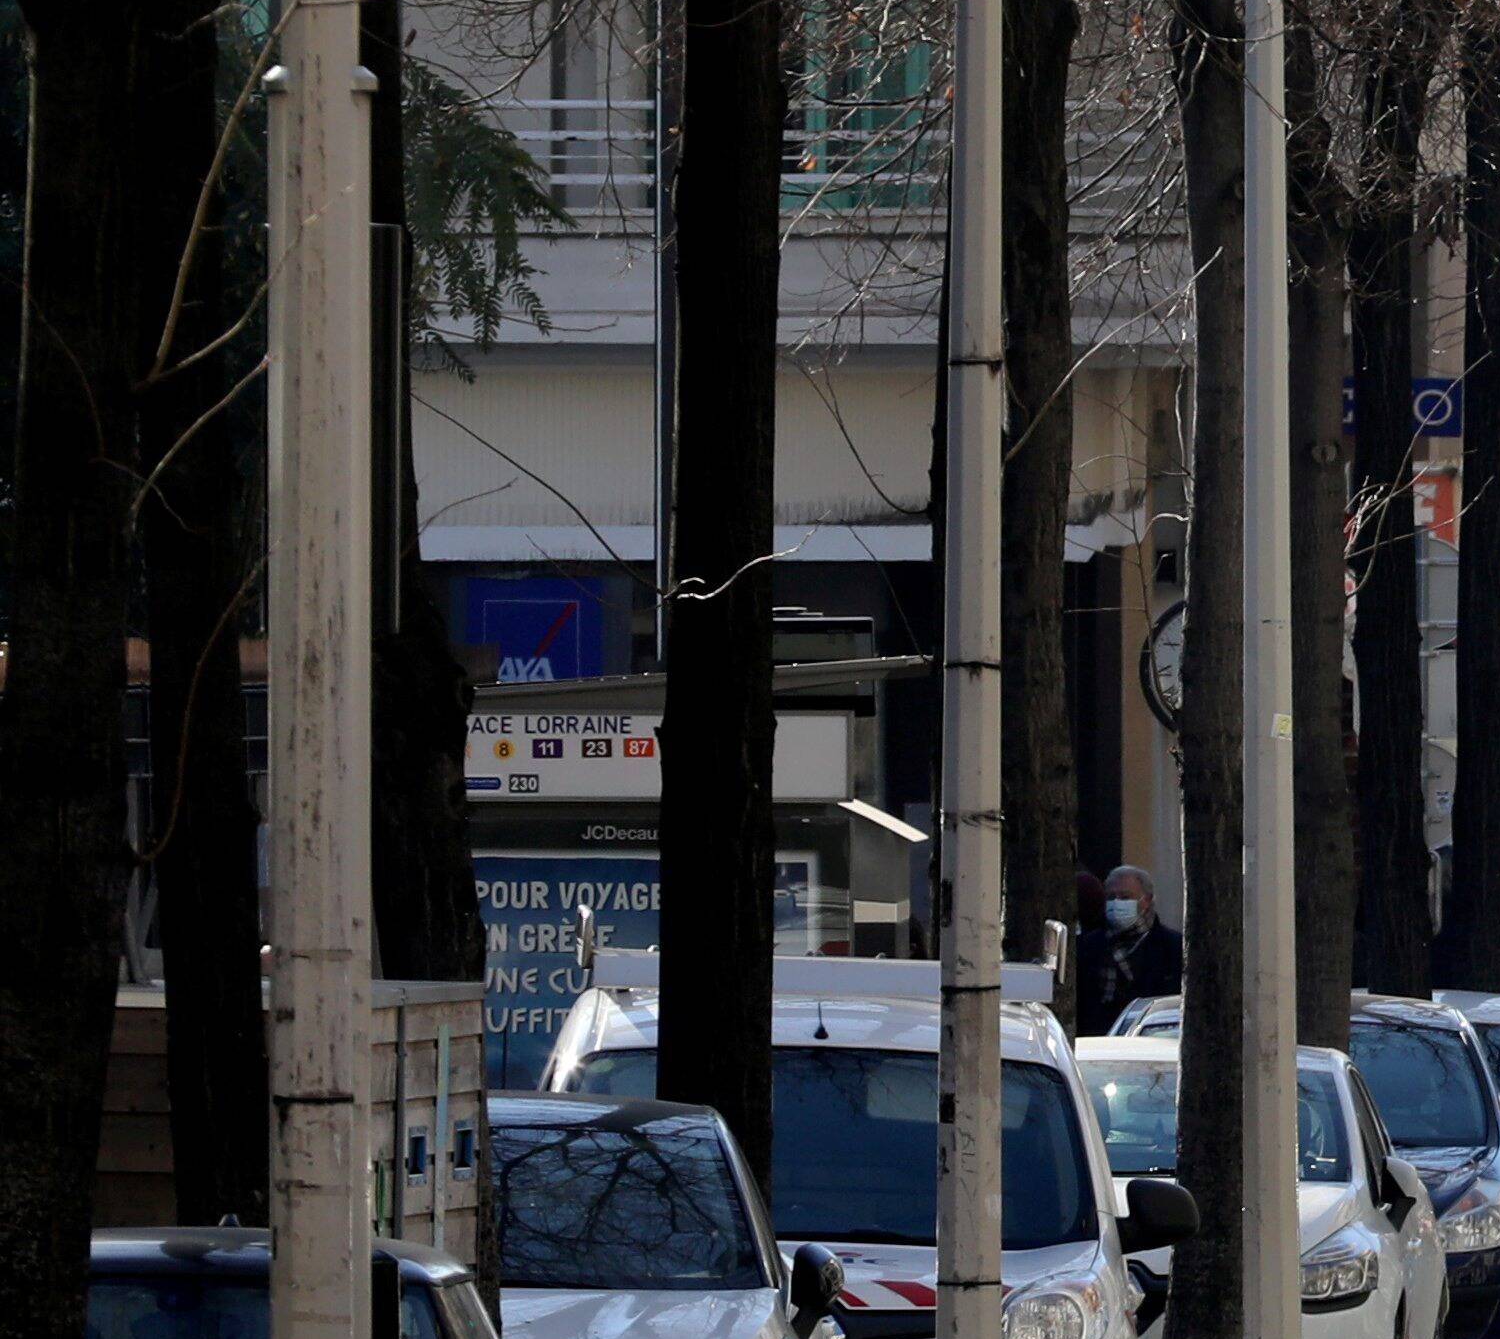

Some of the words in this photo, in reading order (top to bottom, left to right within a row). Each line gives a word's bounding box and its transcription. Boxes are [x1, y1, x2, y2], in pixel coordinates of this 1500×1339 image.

[525, 715, 632, 735] LORRAINE
[499, 742, 509, 757] 8
[537, 741, 555, 756] 11
[586, 741, 608, 756] 23
[629, 740, 650, 755] 87
[511, 776, 537, 791] 230
[475, 880, 549, 910] POUR
[518, 917, 615, 953] GRÈE
